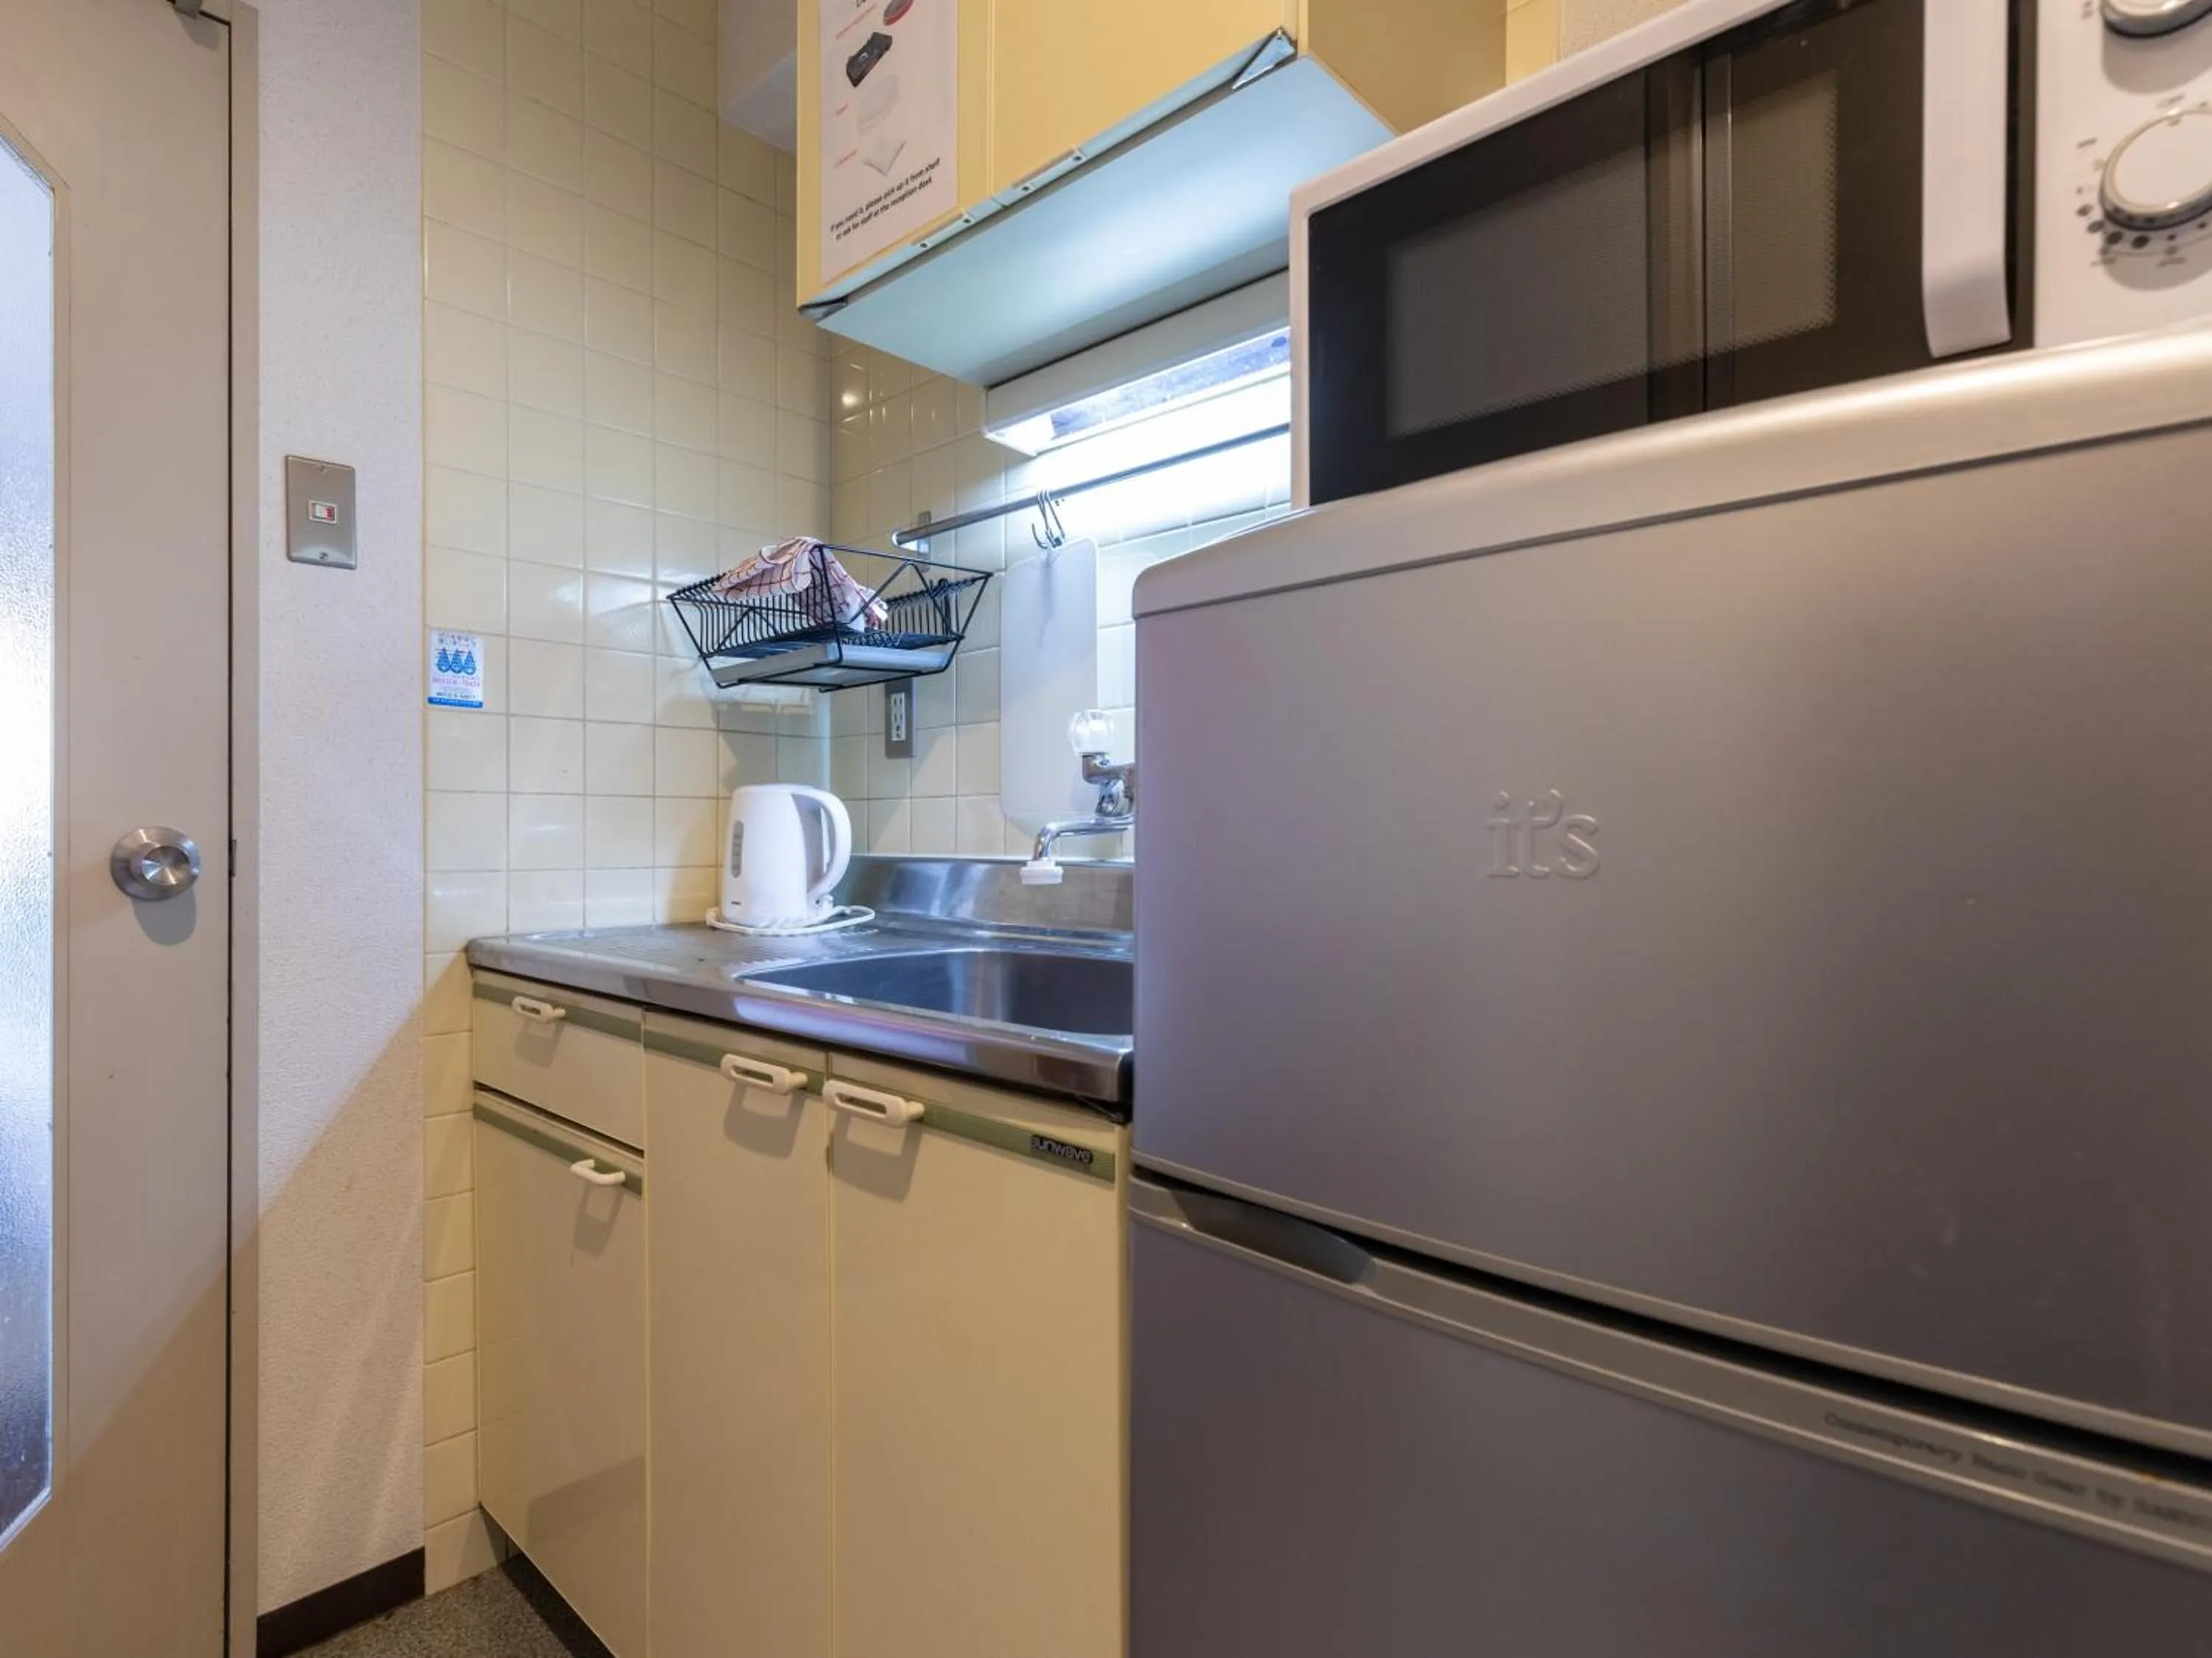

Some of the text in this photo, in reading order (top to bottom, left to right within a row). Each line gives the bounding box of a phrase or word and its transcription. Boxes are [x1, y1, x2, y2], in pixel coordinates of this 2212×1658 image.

[865, 195, 883, 212] please
[883, 187, 895, 199] pick
[896, 182, 904, 191] up
[910, 169, 925, 181] from
[925, 157, 940, 173] shelf
[880, 203, 890, 212] the
[890, 187, 917, 207] reception
[918, 176, 932, 190] desk
[1485, 788, 1601, 881] it's
[1032, 1136, 1092, 1164] sunwave
